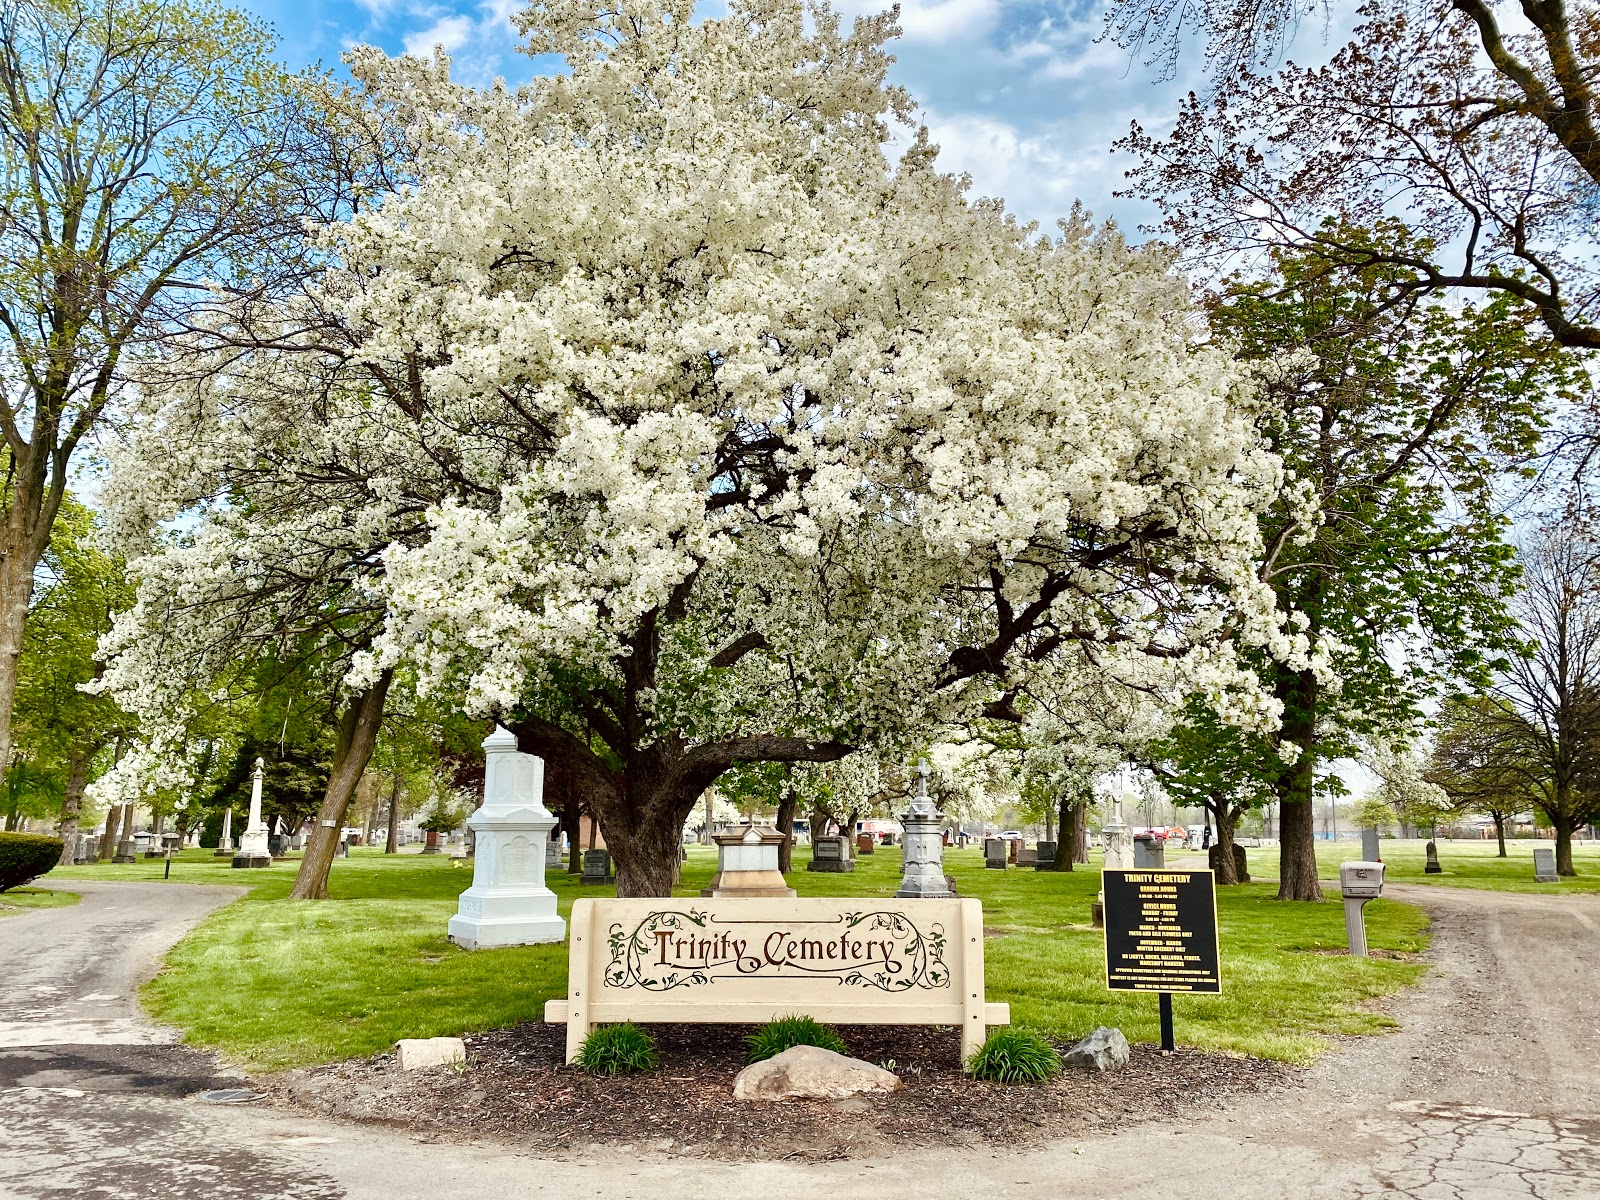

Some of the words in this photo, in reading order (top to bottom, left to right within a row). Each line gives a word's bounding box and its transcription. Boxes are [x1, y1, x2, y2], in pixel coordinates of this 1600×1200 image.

[1124, 874, 1152, 882] TRINITY
[1154, 874, 1191, 883] CEMETERY
[652, 930, 758, 973] Trinity
[763, 931, 902, 973] Cemetery
